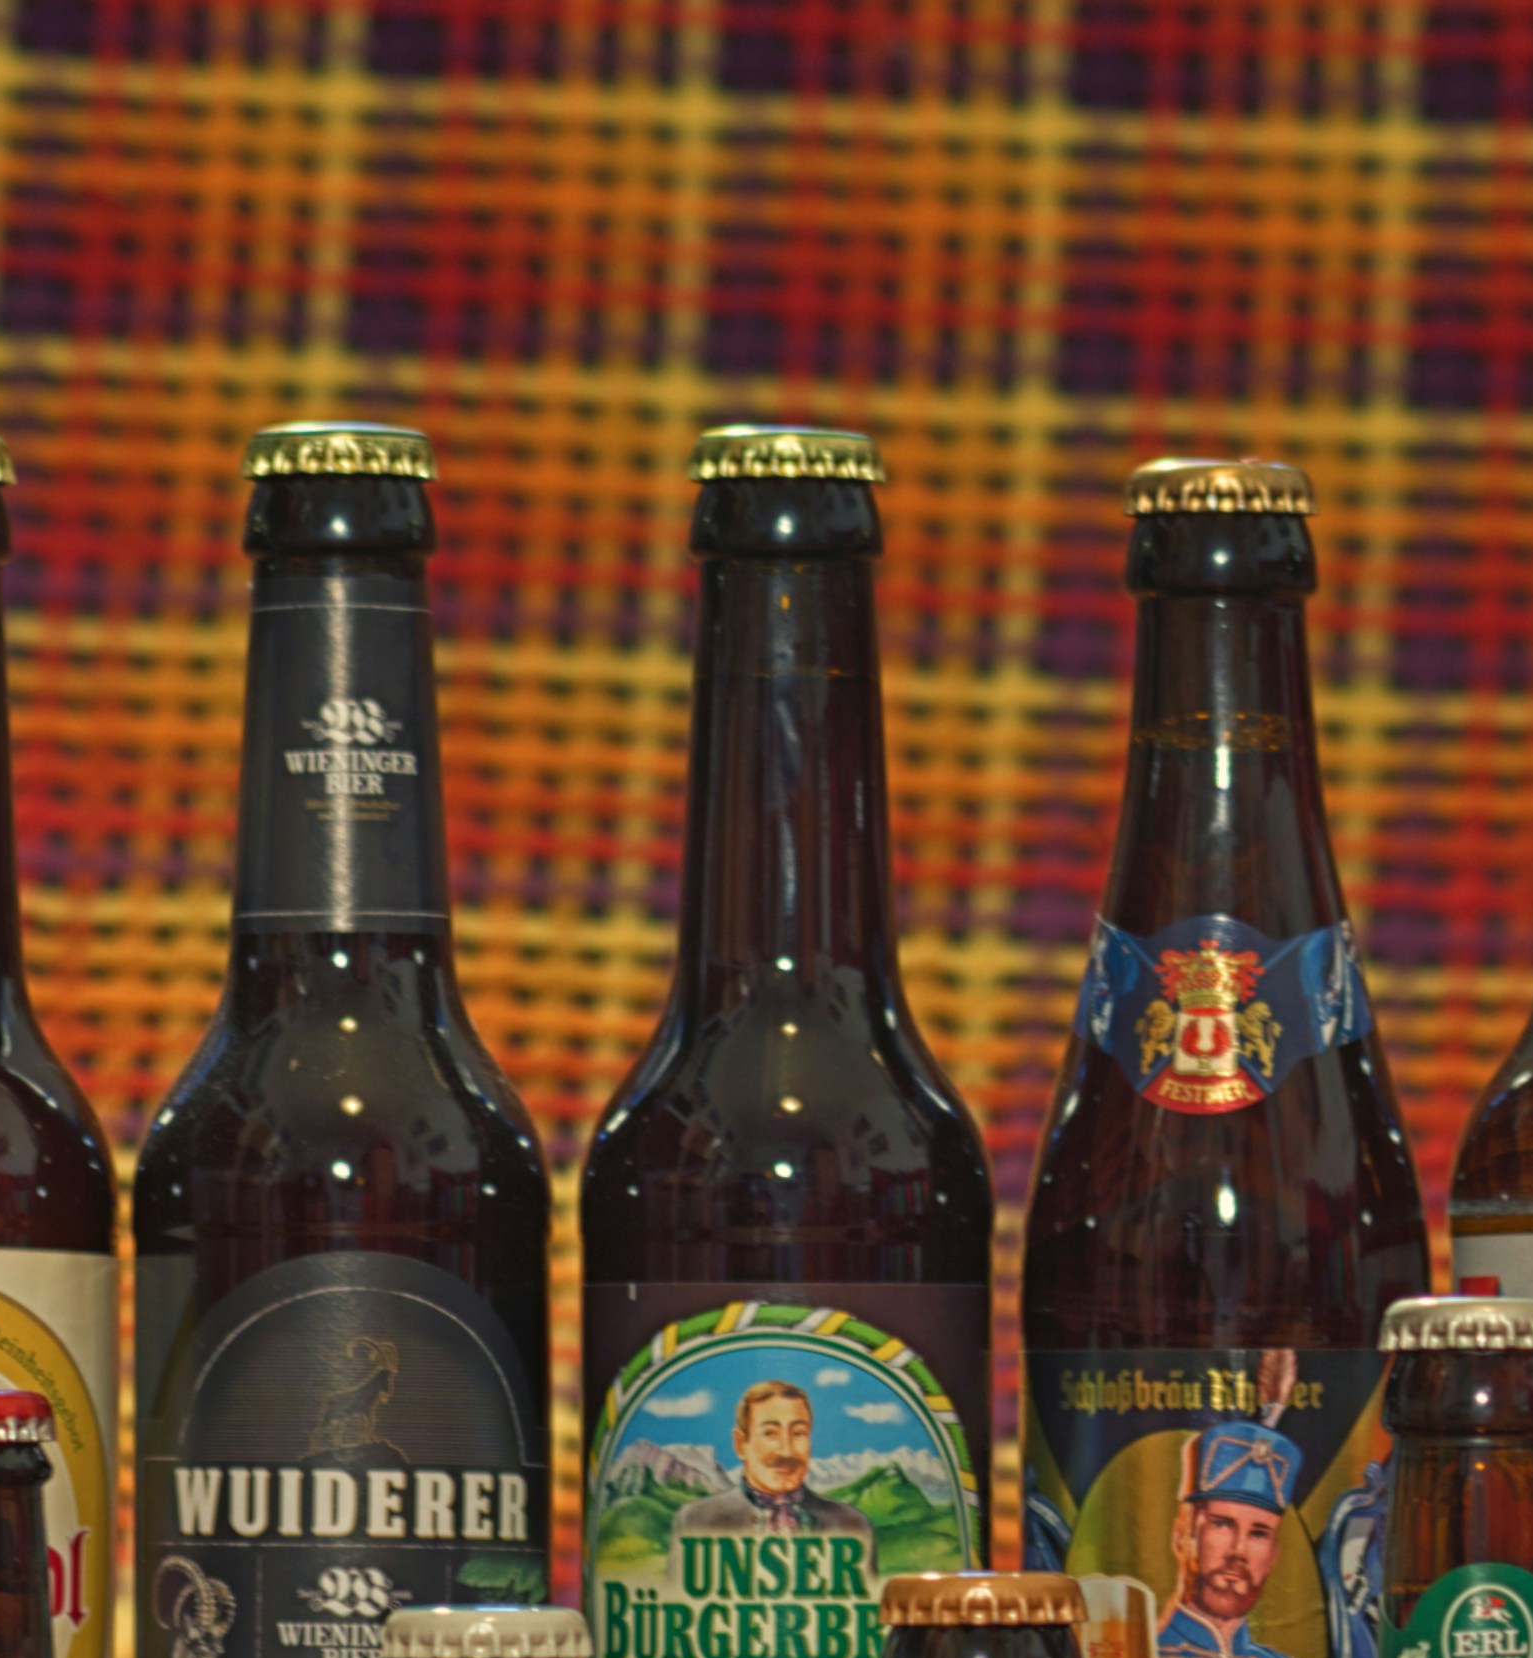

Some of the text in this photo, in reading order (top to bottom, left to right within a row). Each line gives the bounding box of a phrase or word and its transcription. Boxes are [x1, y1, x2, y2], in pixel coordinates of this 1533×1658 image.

[284, 750, 418, 776] WIENINGER
[324, 773, 385, 795] BIER
[174, 1466, 529, 1541] WUIDERER
[680, 1536, 869, 1599] UNSER
[275, 1621, 388, 1649] WIENIN
[1452, 1628, 1528, 1658] ERL
